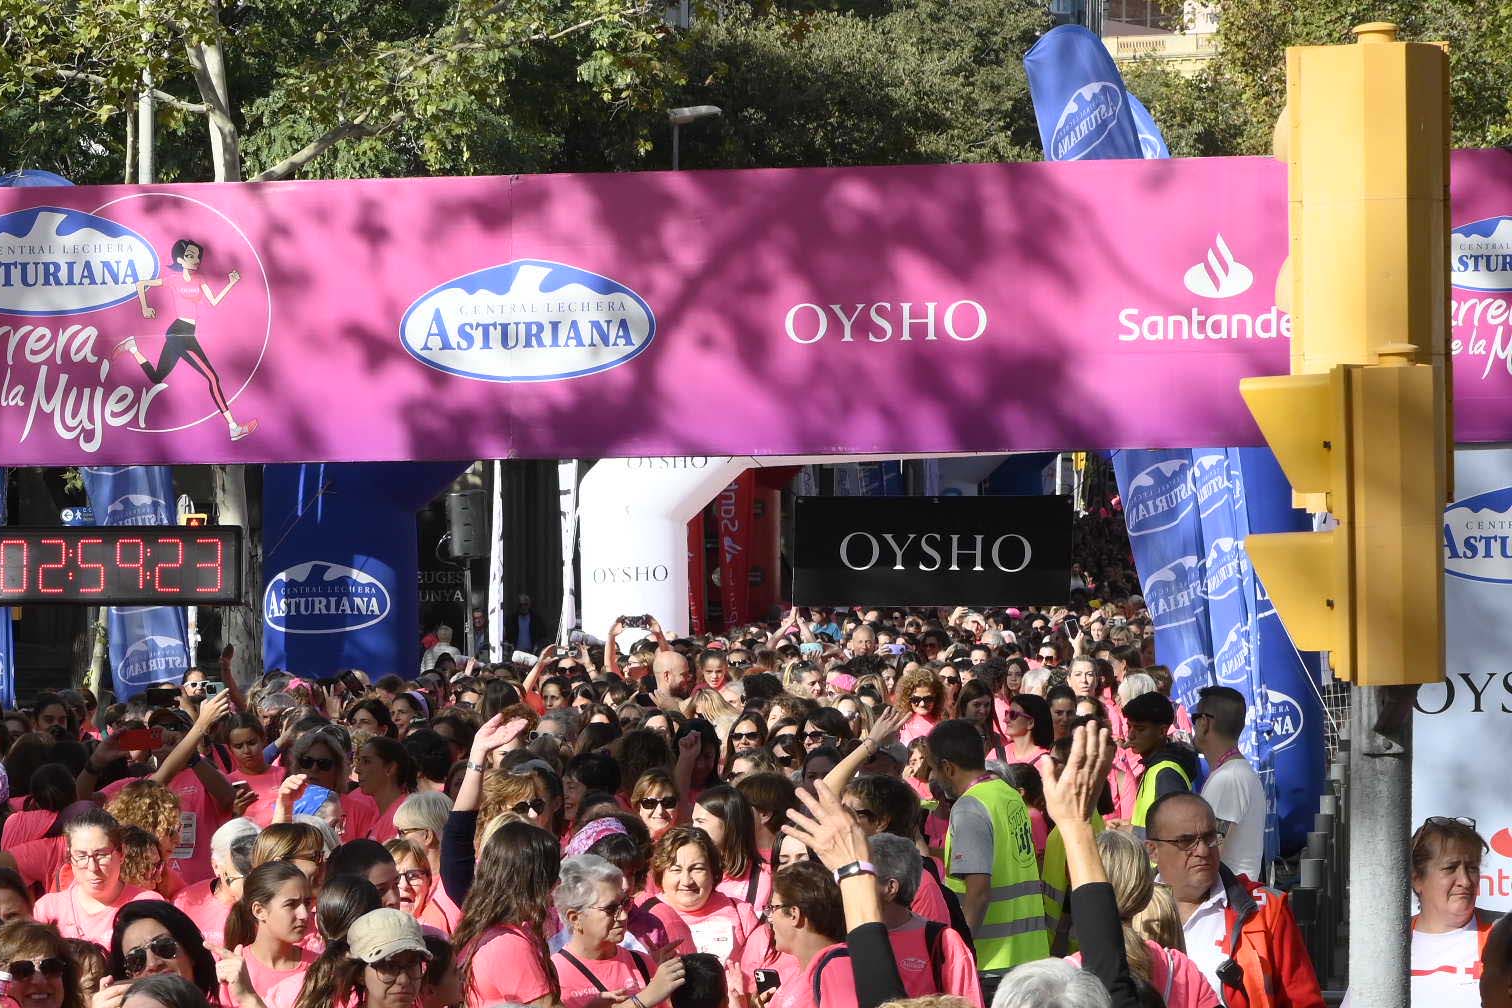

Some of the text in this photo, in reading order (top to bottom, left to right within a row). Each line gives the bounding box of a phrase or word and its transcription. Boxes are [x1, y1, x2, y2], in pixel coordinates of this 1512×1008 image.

[63, 243, 135, 254] LECHERA
[459, 301, 627, 315] CENTRAL LECHERA
[785, 299, 988, 344] OYSHO
[1118, 307, 1294, 341] Santande
[420, 307, 636, 350] ASTURIANA
[1469, 328, 1487, 356] la
[0, 368, 24, 408] la
[20, 355, 168, 452] Mujer
[0, 540, 222, 592] 02:59:23
[839, 532, 1033, 573] OYSHO
[593, 564, 668, 583] OYSHO
[268, 590, 381, 619] ASTURIANA
